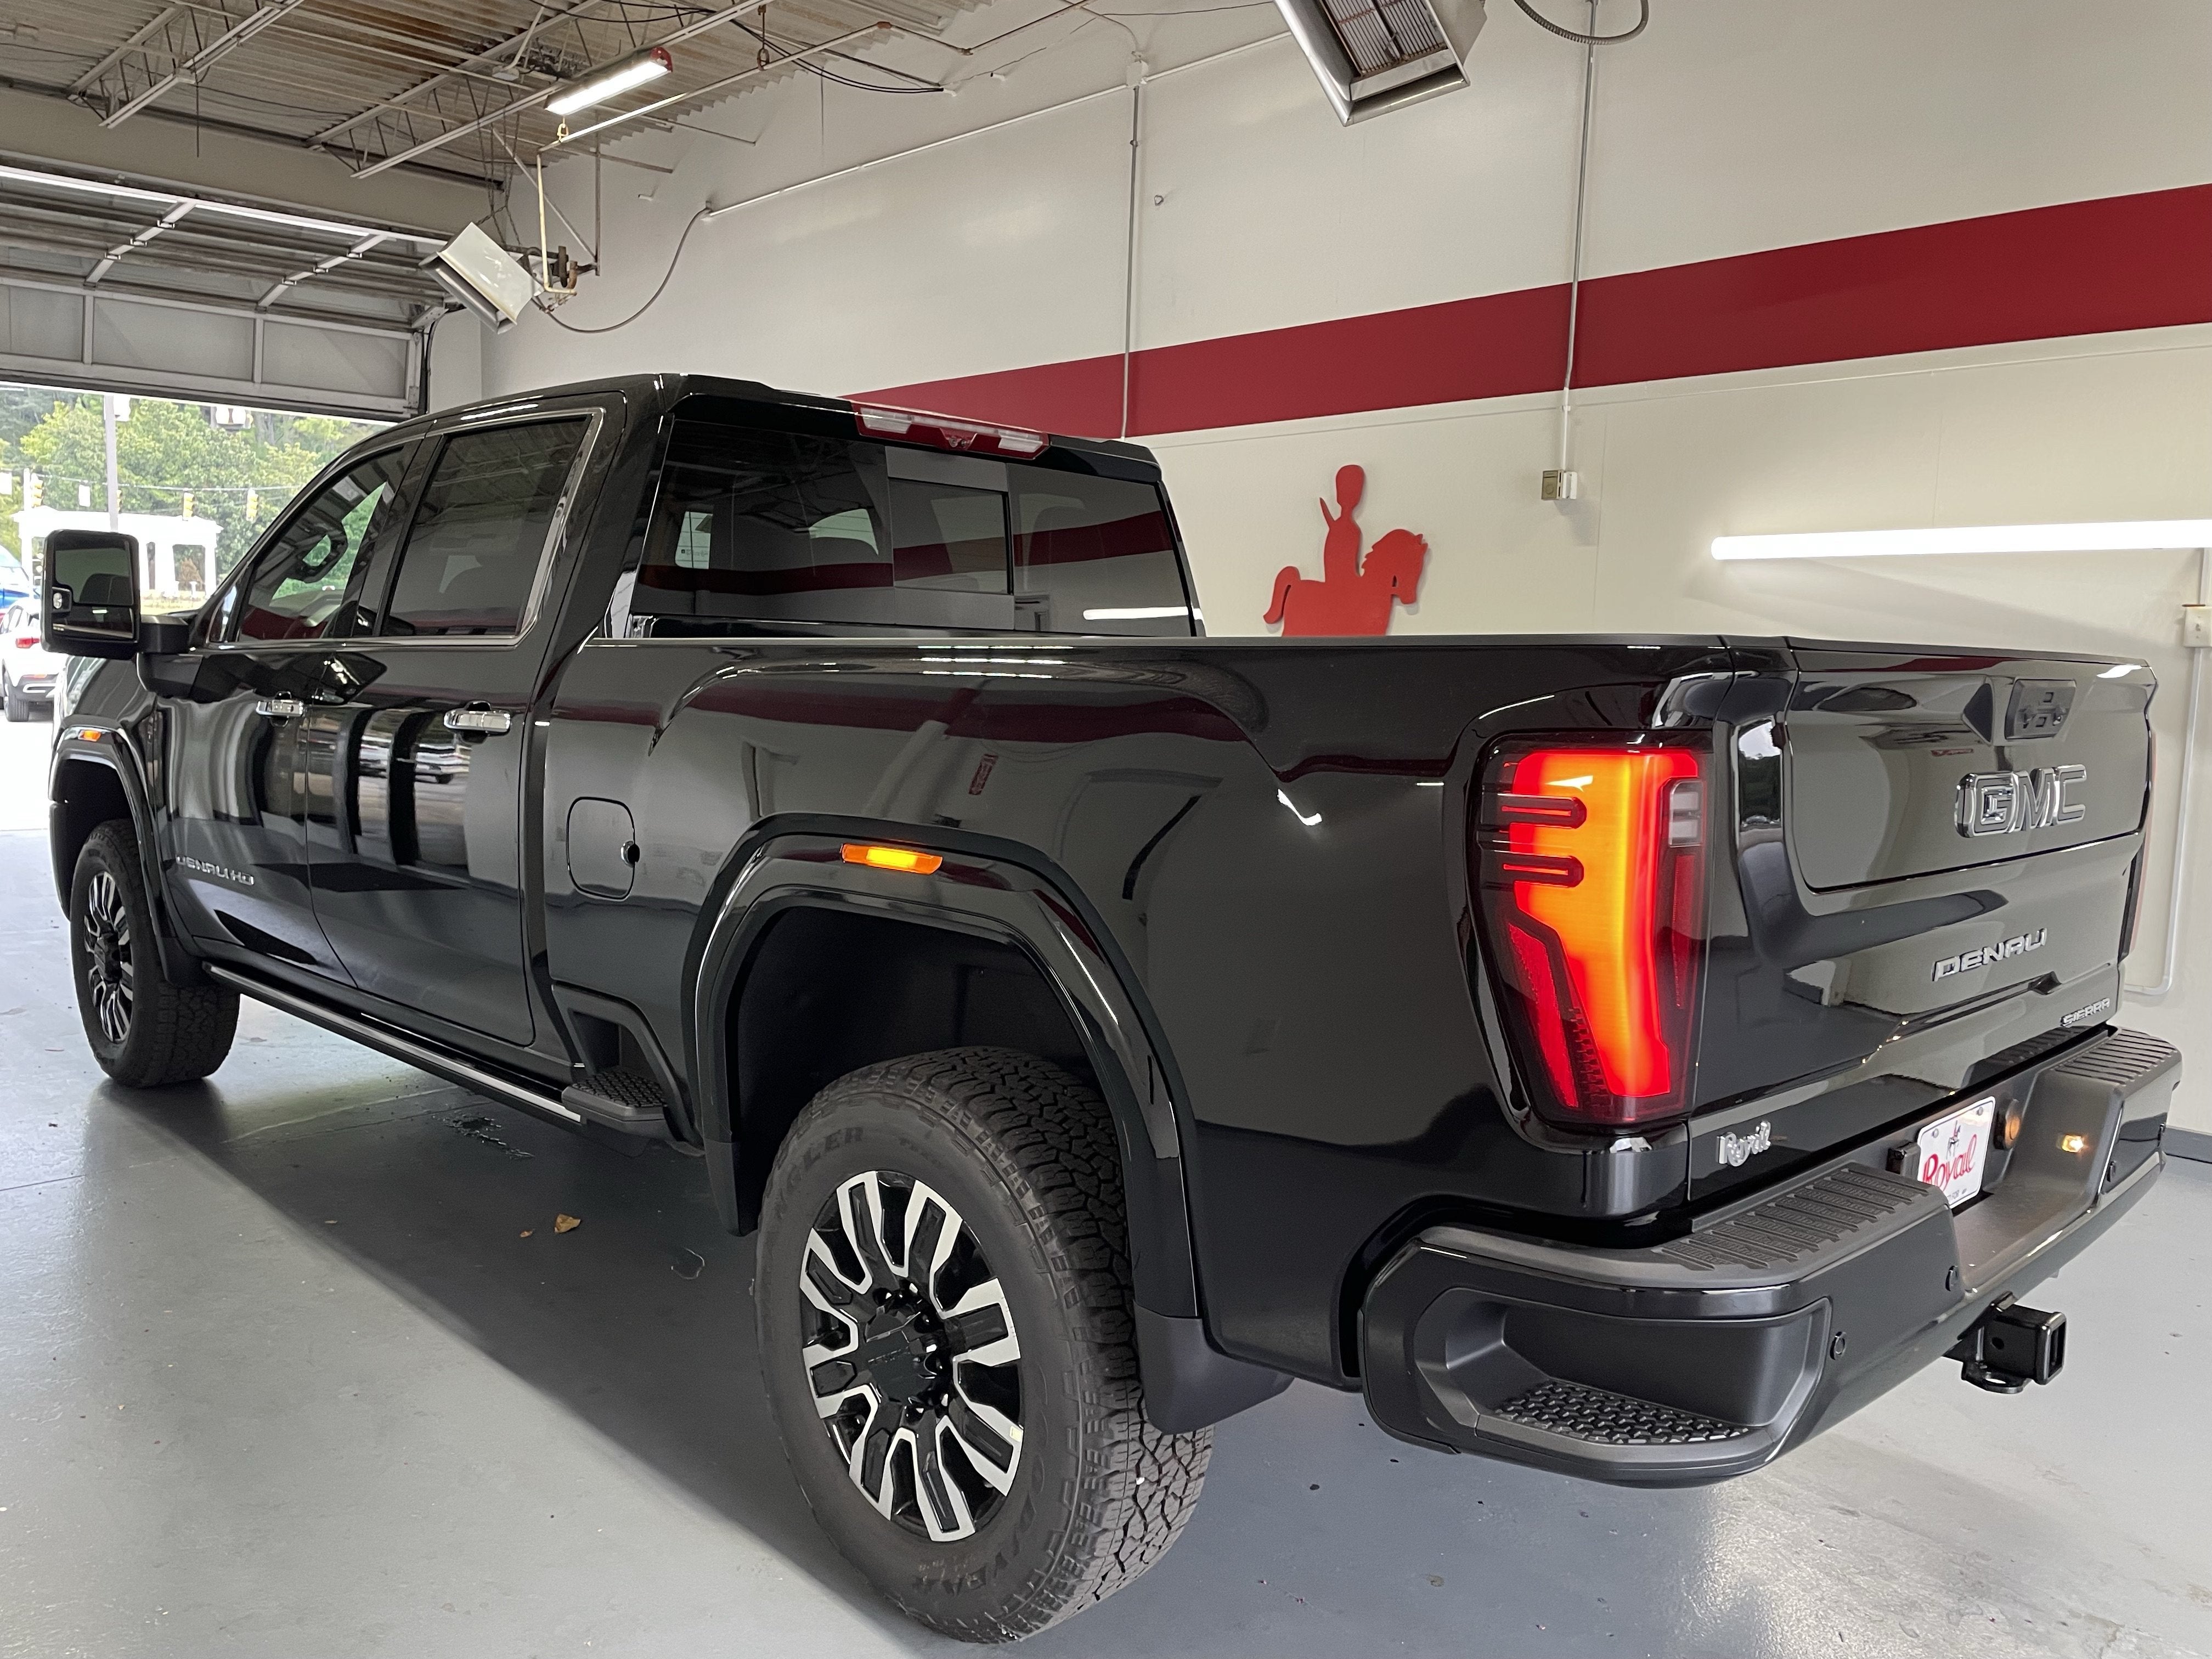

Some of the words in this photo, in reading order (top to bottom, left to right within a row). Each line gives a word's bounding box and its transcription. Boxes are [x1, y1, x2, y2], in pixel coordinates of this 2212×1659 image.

[1954, 764, 2087, 838] GMC
[1931, 928, 2047, 982] DENALI
[2060, 997, 2111, 1028] SIERRA
[1922, 1134, 1977, 1192] Royal
